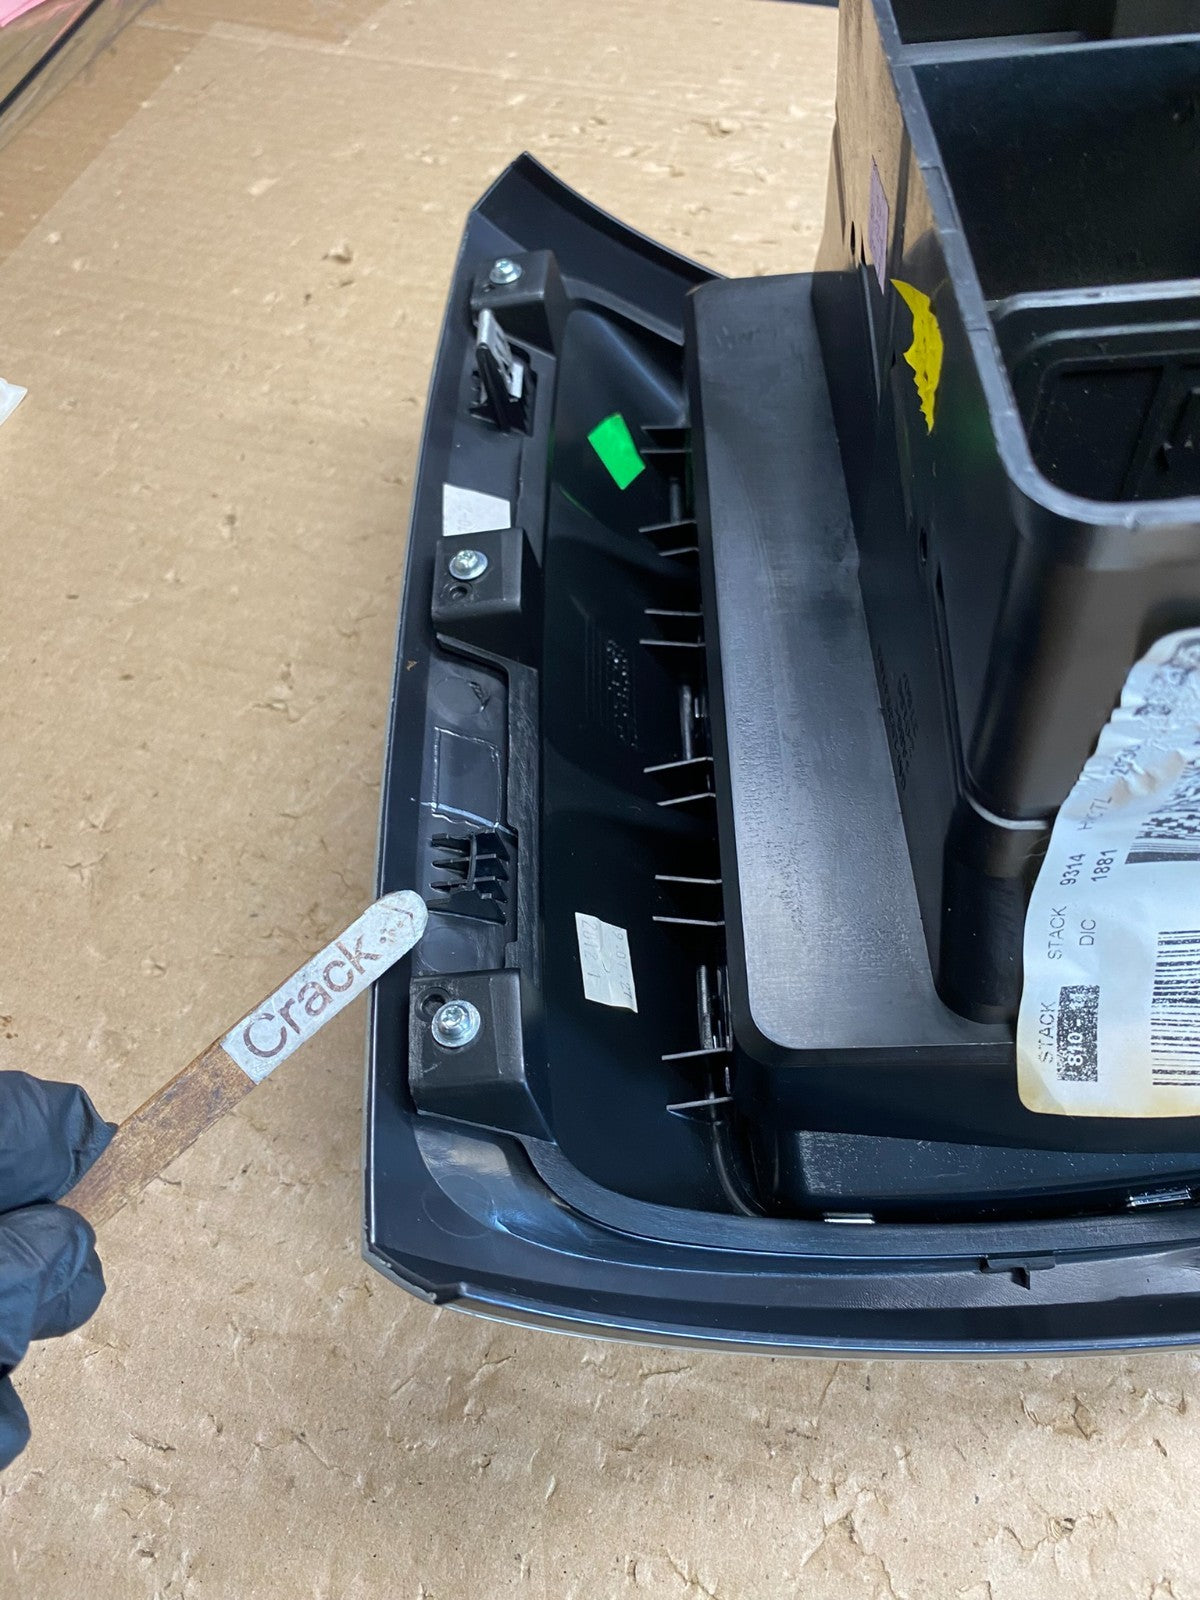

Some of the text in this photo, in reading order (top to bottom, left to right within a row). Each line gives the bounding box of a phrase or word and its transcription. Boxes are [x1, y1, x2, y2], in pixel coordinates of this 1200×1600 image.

[1038, 1001, 1056, 1064] STACK
[1047, 905, 1067, 960] STACK
[1060, 853, 1086, 886] 9314
[1079, 849, 1118, 946] DIC 1881
[243, 934, 383, 1058] Crack
